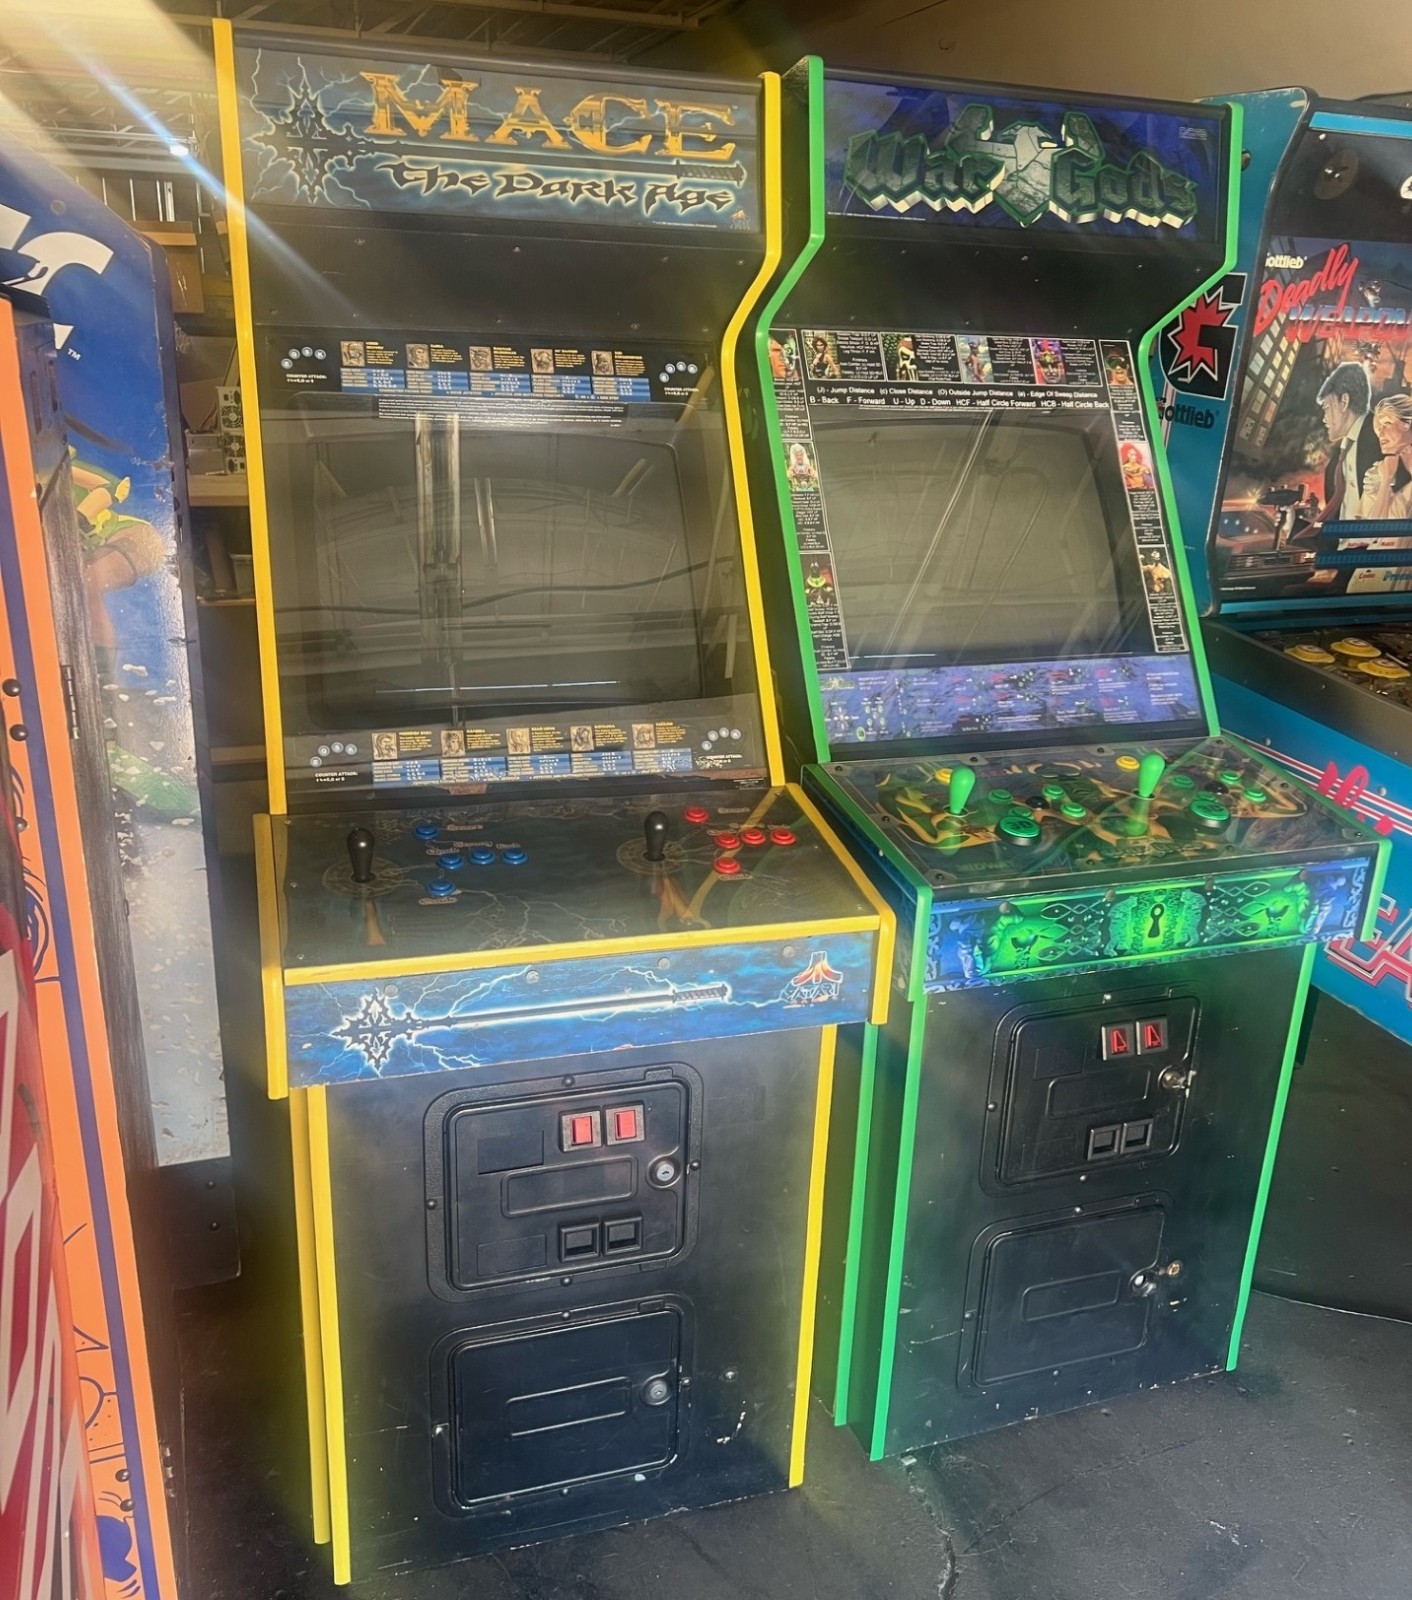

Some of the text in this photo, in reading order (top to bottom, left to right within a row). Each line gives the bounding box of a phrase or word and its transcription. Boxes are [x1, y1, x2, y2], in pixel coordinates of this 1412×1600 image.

[360, 71, 736, 160] MACE
[638, 180, 735, 215] Age
[845, 129, 1198, 229] War Gods
[1253, 243, 1360, 338] Deadly
[848, 387, 875, 395] Distance
[907, 388, 933, 396] Distance
[858, 397, 886, 405] Forward
[931, 398, 951, 406] Down
[1094, 401, 1110, 409] Back
